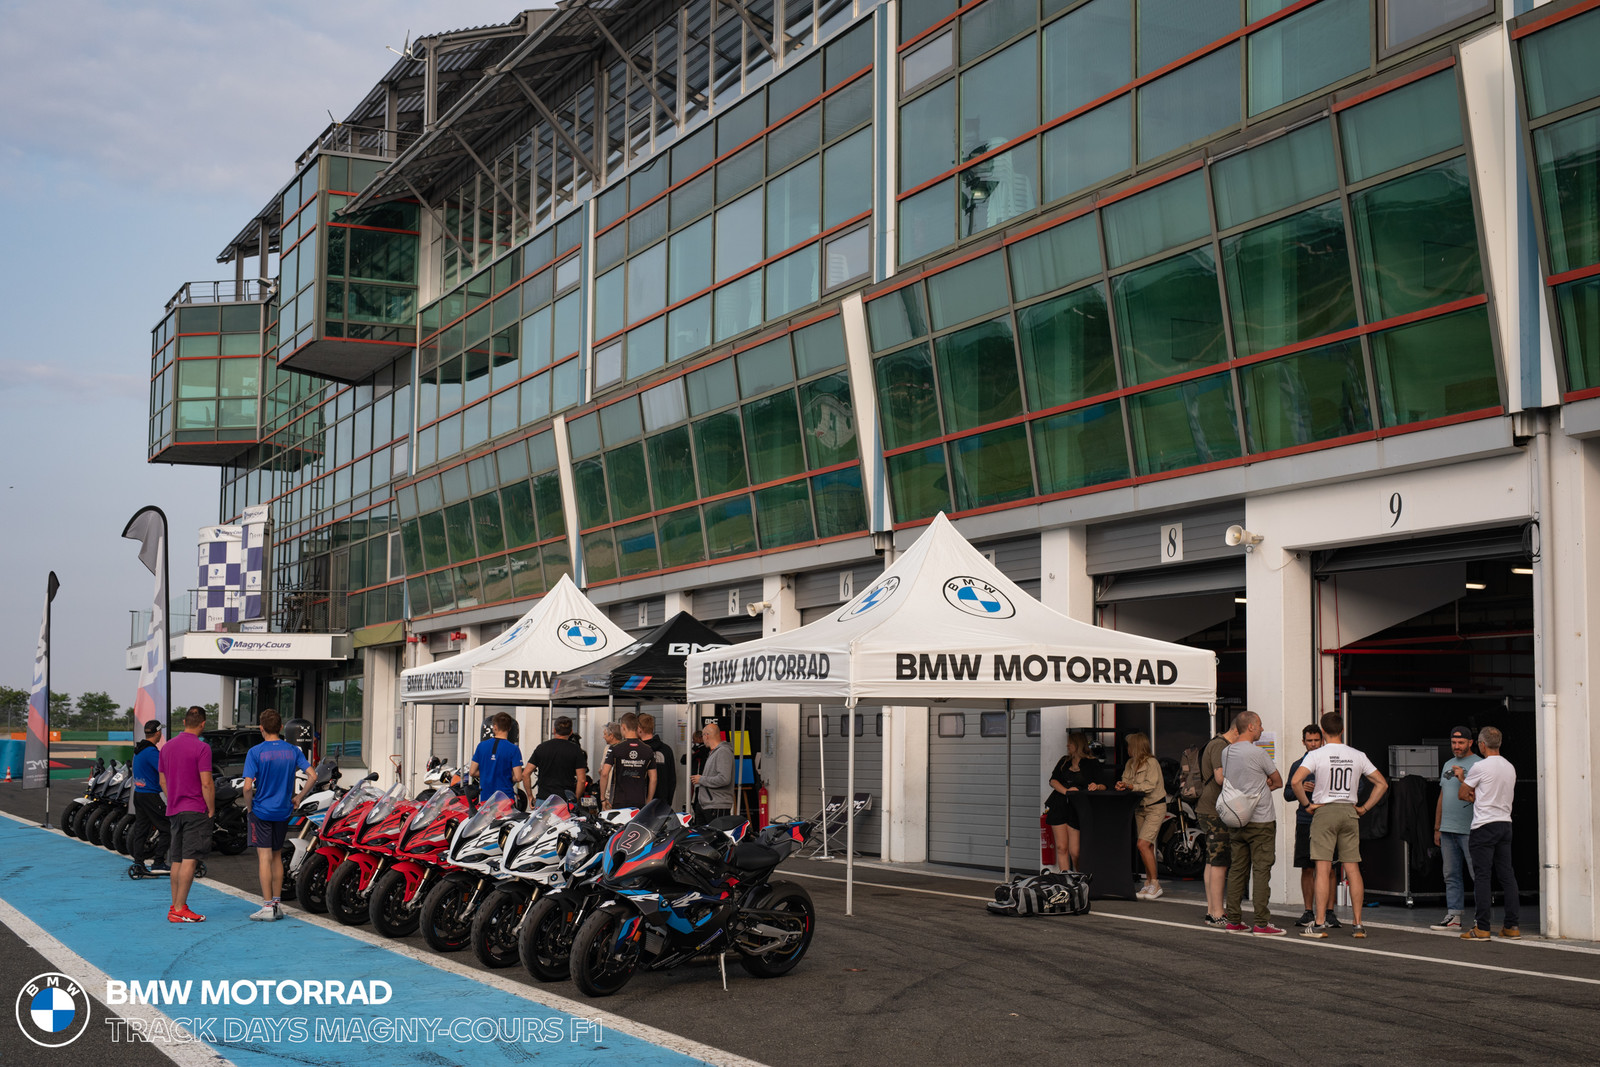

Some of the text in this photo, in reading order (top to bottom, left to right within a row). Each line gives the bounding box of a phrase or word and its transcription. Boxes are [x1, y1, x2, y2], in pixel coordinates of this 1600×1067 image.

[1389, 492, 1403, 528] 9
[1166, 527, 1177, 558] 8
[843, 573, 850, 598] 6
[947, 578, 997, 595] BMW
[730, 591, 737, 613] 5
[562, 620, 597, 631] BMW
[233, 640, 292, 650] Magny-Cours
[701, 652, 830, 686] BMW MOTORRAD
[895, 652, 1179, 686] BMW MOTORRAD
[407, 671, 464, 692] BMW MOTORRAD
[1330, 767, 1352, 791] 100
[621, 830, 641, 849] 2
